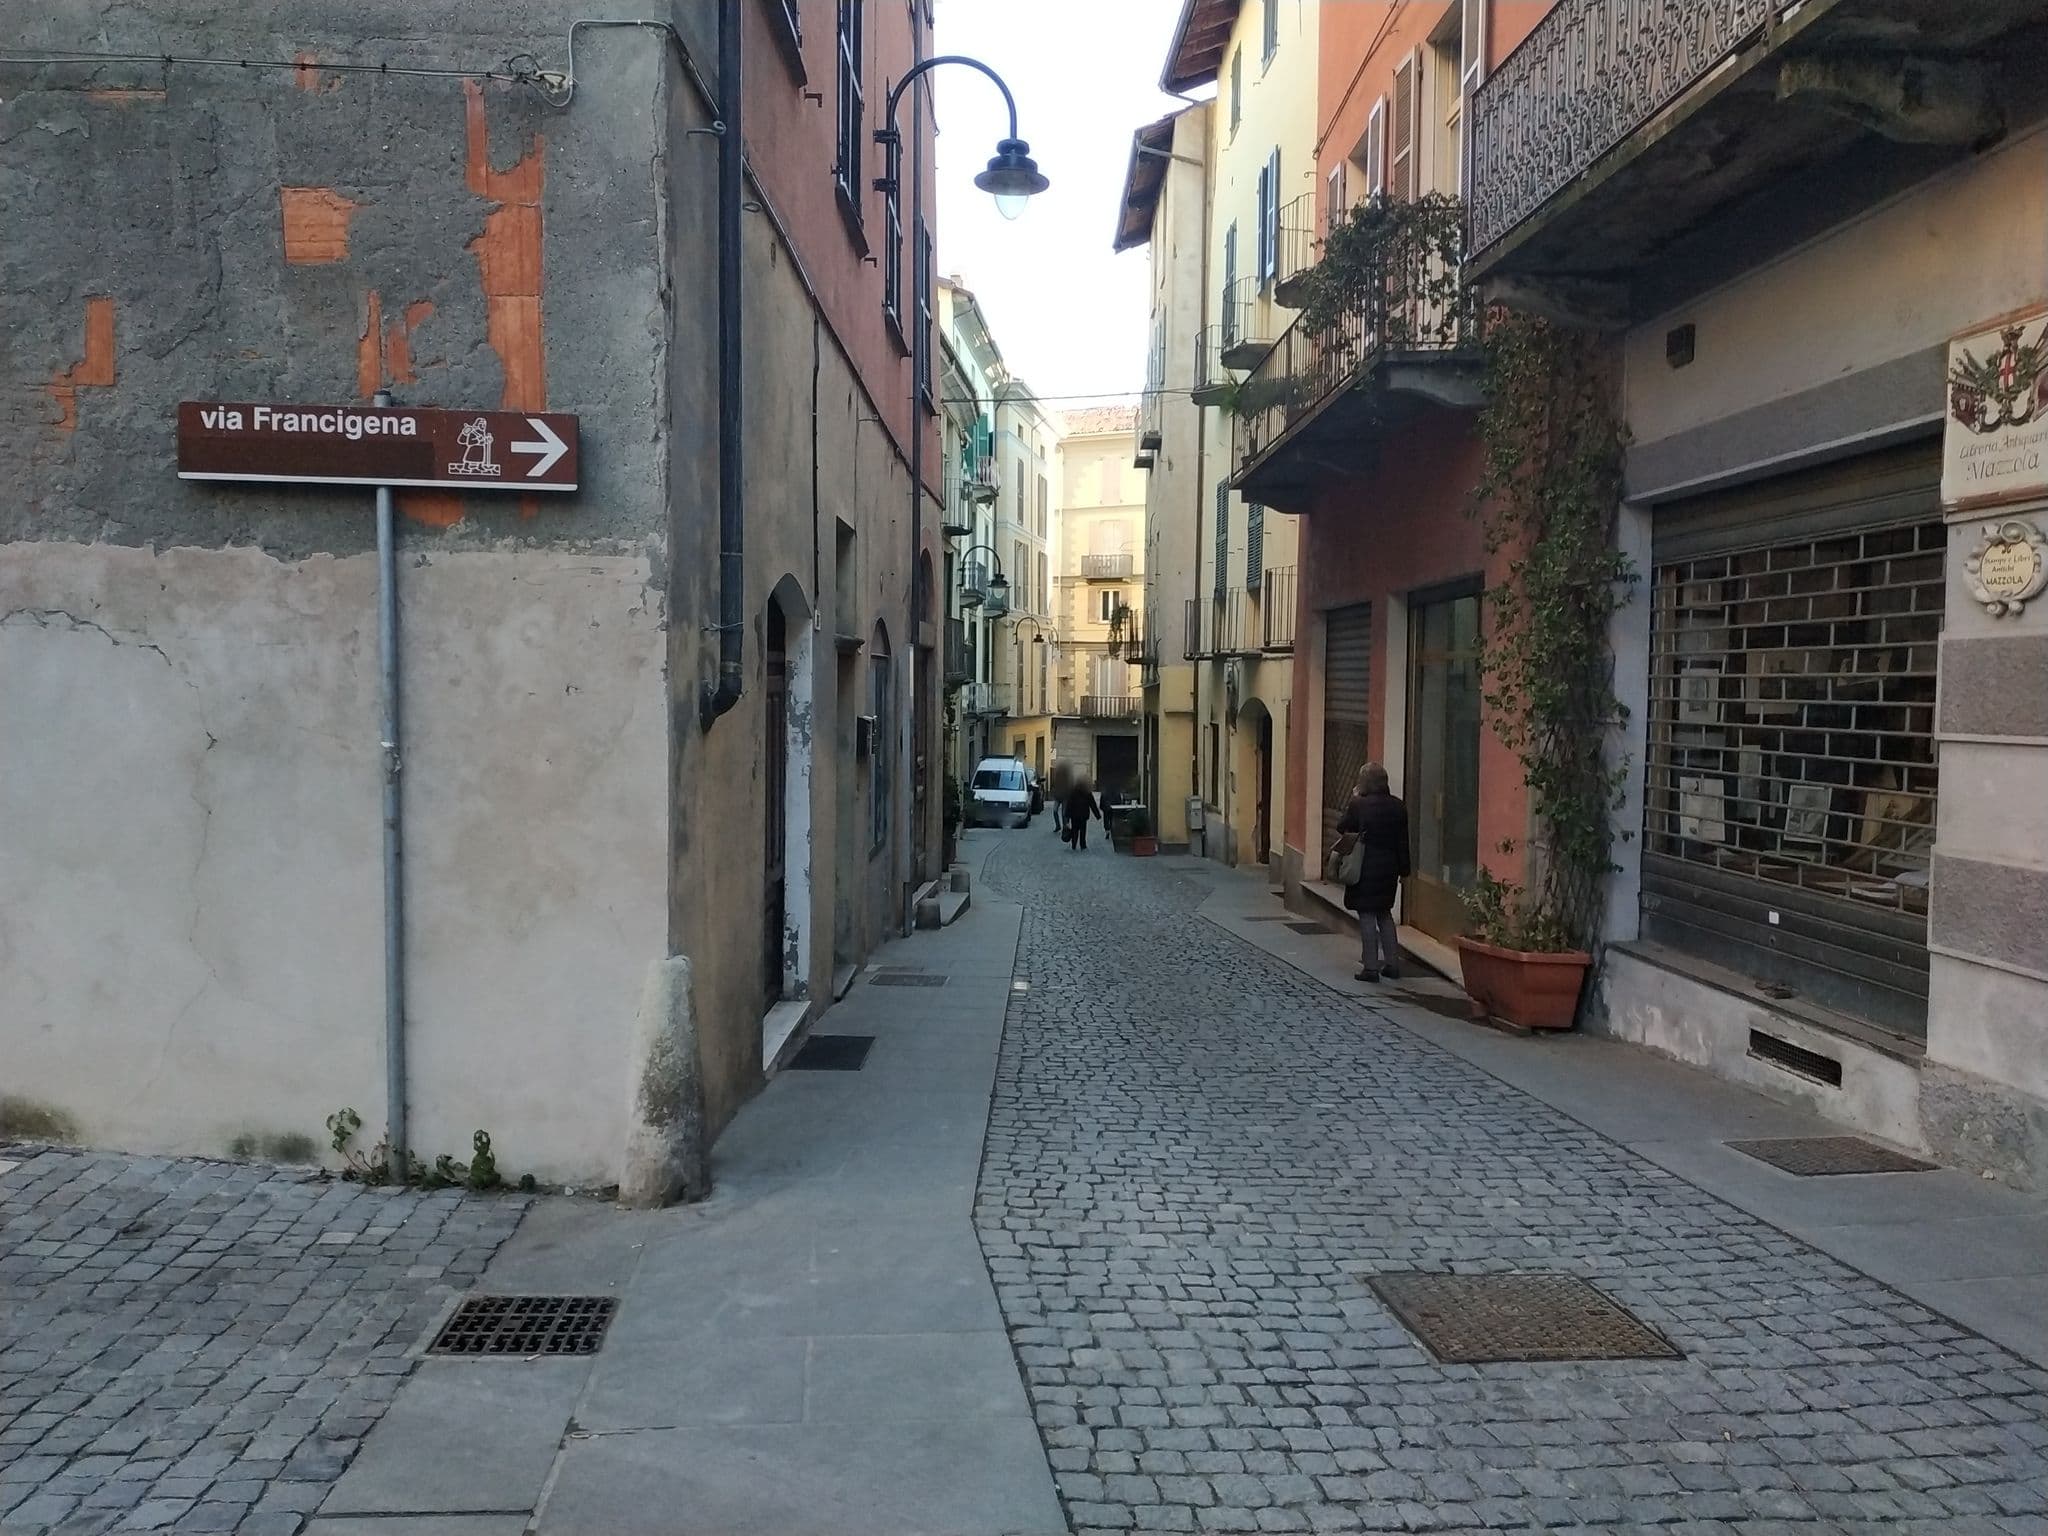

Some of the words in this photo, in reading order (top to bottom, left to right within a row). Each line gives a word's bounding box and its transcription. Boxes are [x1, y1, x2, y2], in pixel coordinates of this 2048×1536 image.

[200, 406, 242, 430] via
[253, 407, 416, 440] Francigena
[1986, 575, 2024, 586] MAZZOLA
